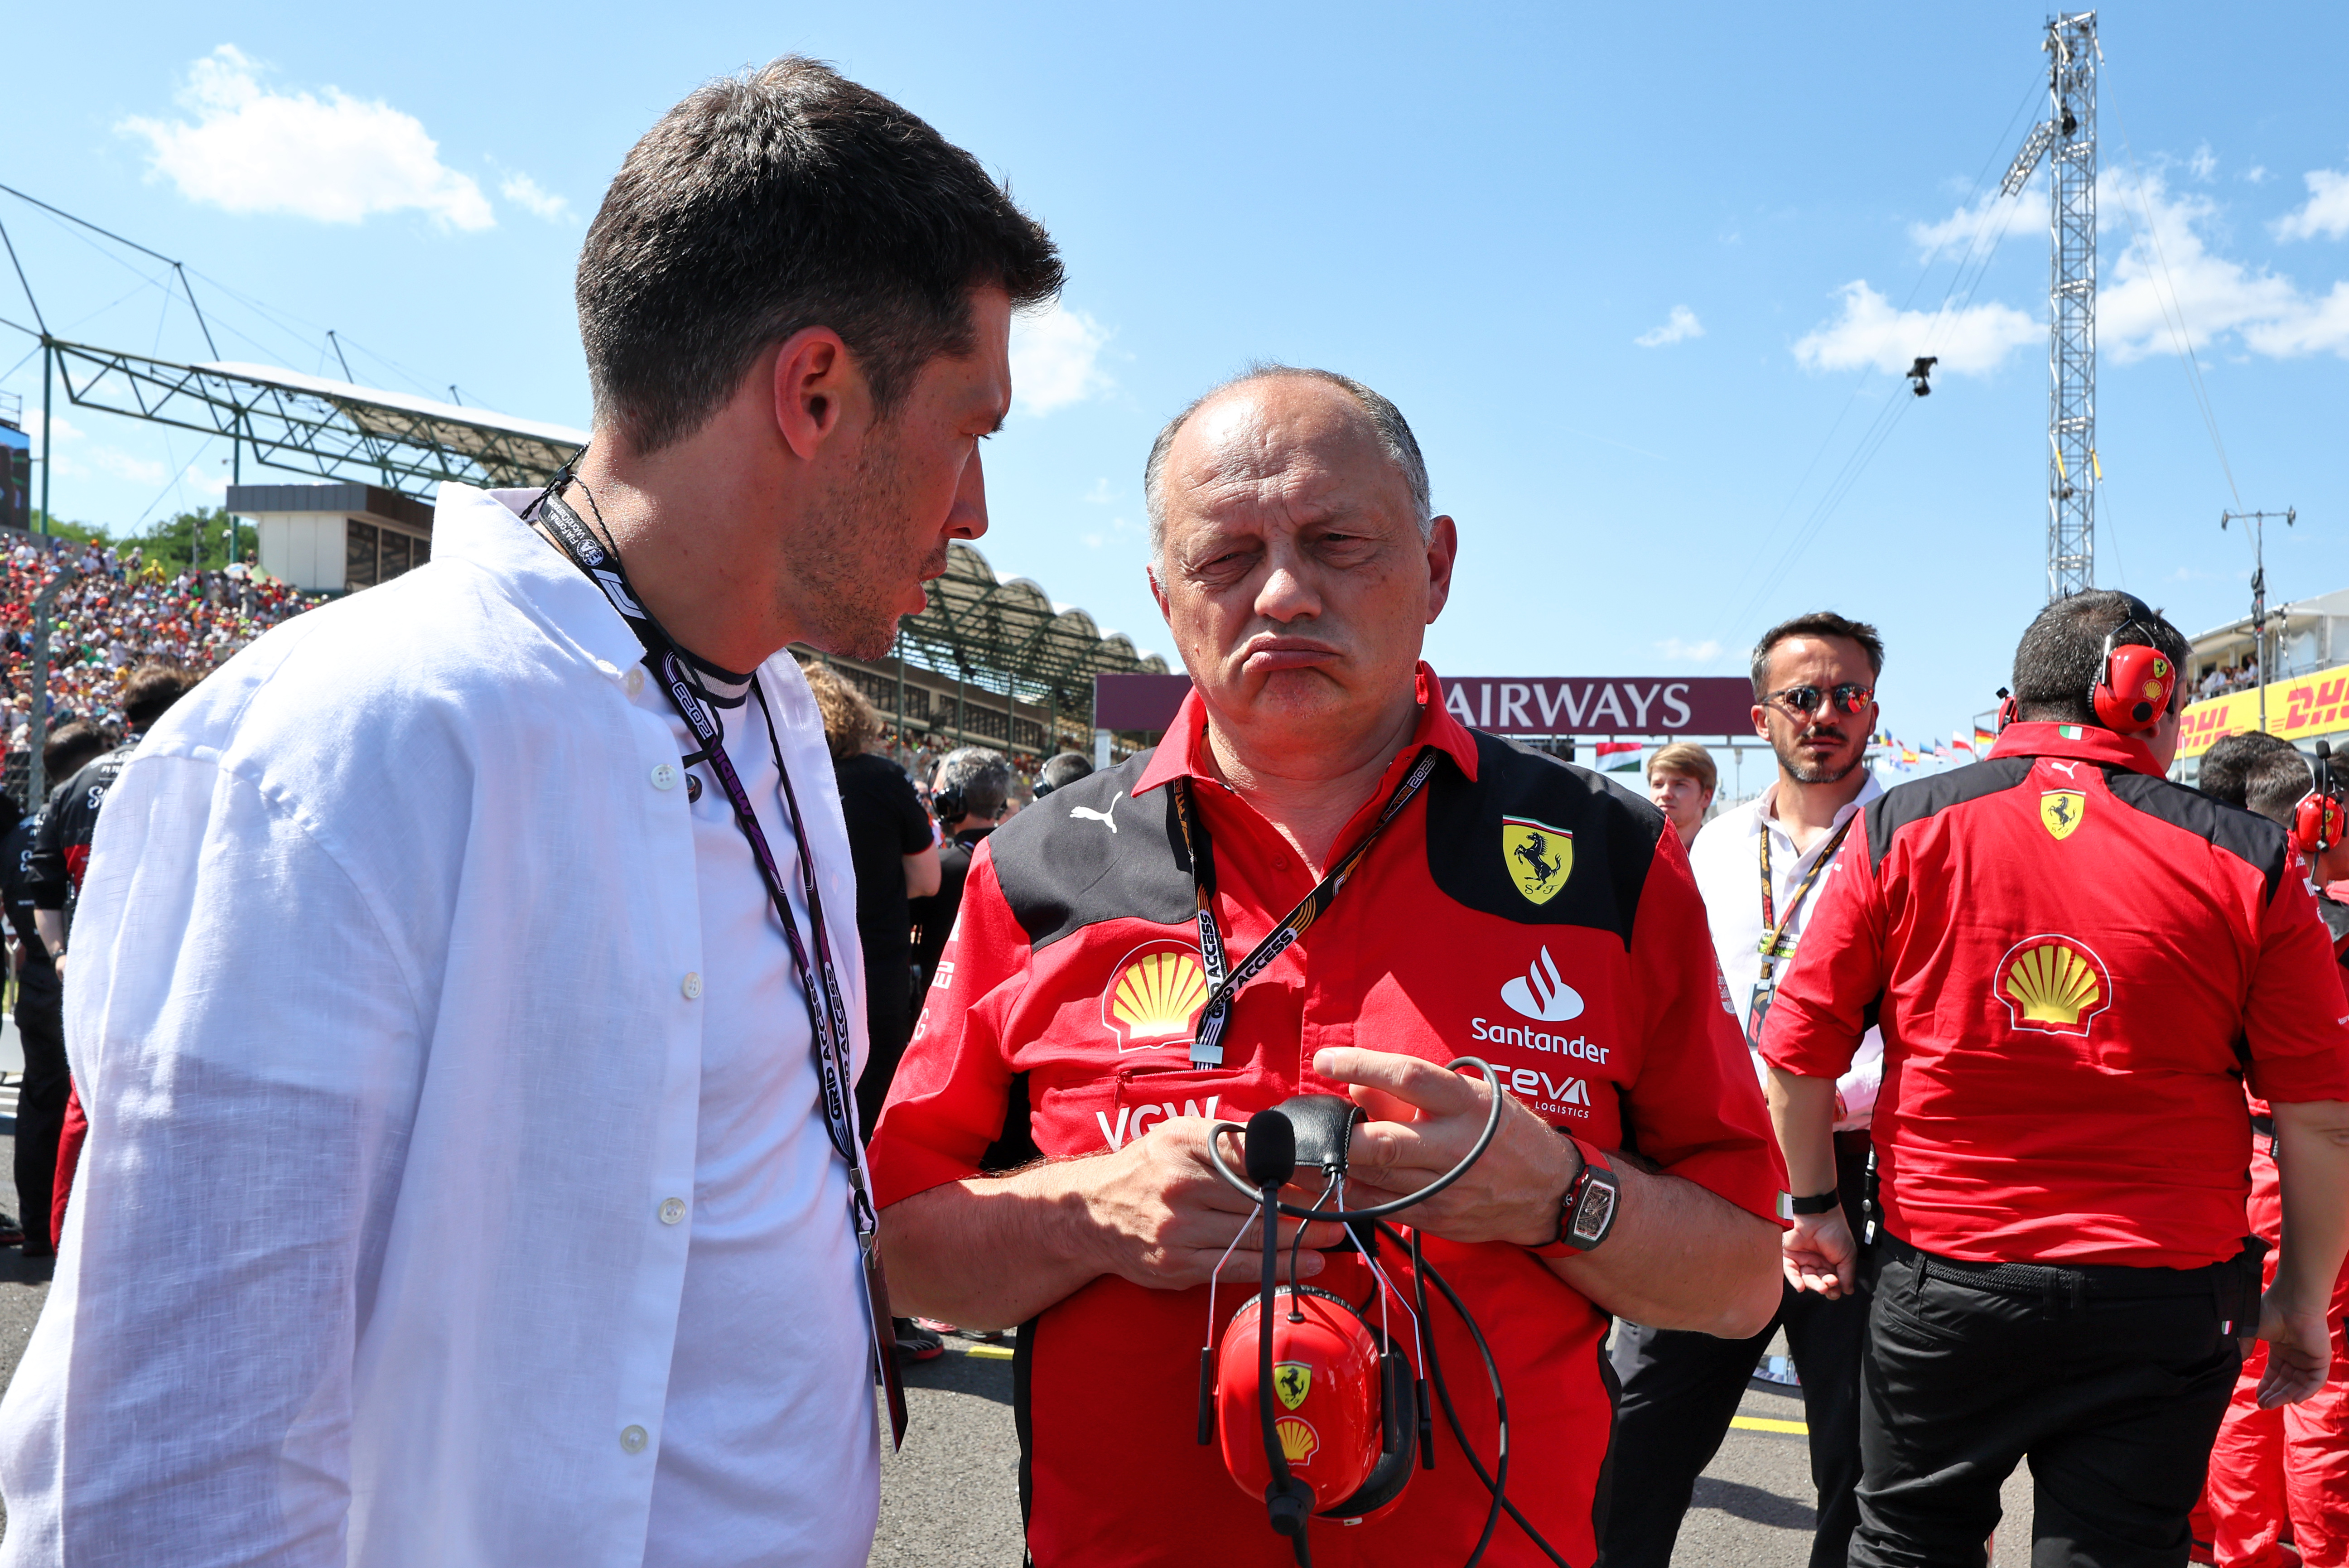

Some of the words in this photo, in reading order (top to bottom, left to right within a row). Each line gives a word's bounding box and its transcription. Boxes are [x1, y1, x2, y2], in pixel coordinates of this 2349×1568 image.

[672, 681, 713, 740] 2023
[1446, 683, 1691, 728] AIRWAYS
[2176, 705, 2232, 750] DHL
[1407, 754, 1436, 789] 2023
[1201, 912, 1221, 978] ACCESS
[1237, 930, 1294, 988] ACCESS
[806, 974, 831, 1061] ACCESS
[826, 968, 850, 1056] ACCESS
[1471, 1018, 1609, 1065] Santander
[826, 1068, 842, 1120] GRID
[1535, 1101, 1590, 1119] LOGISTICS
